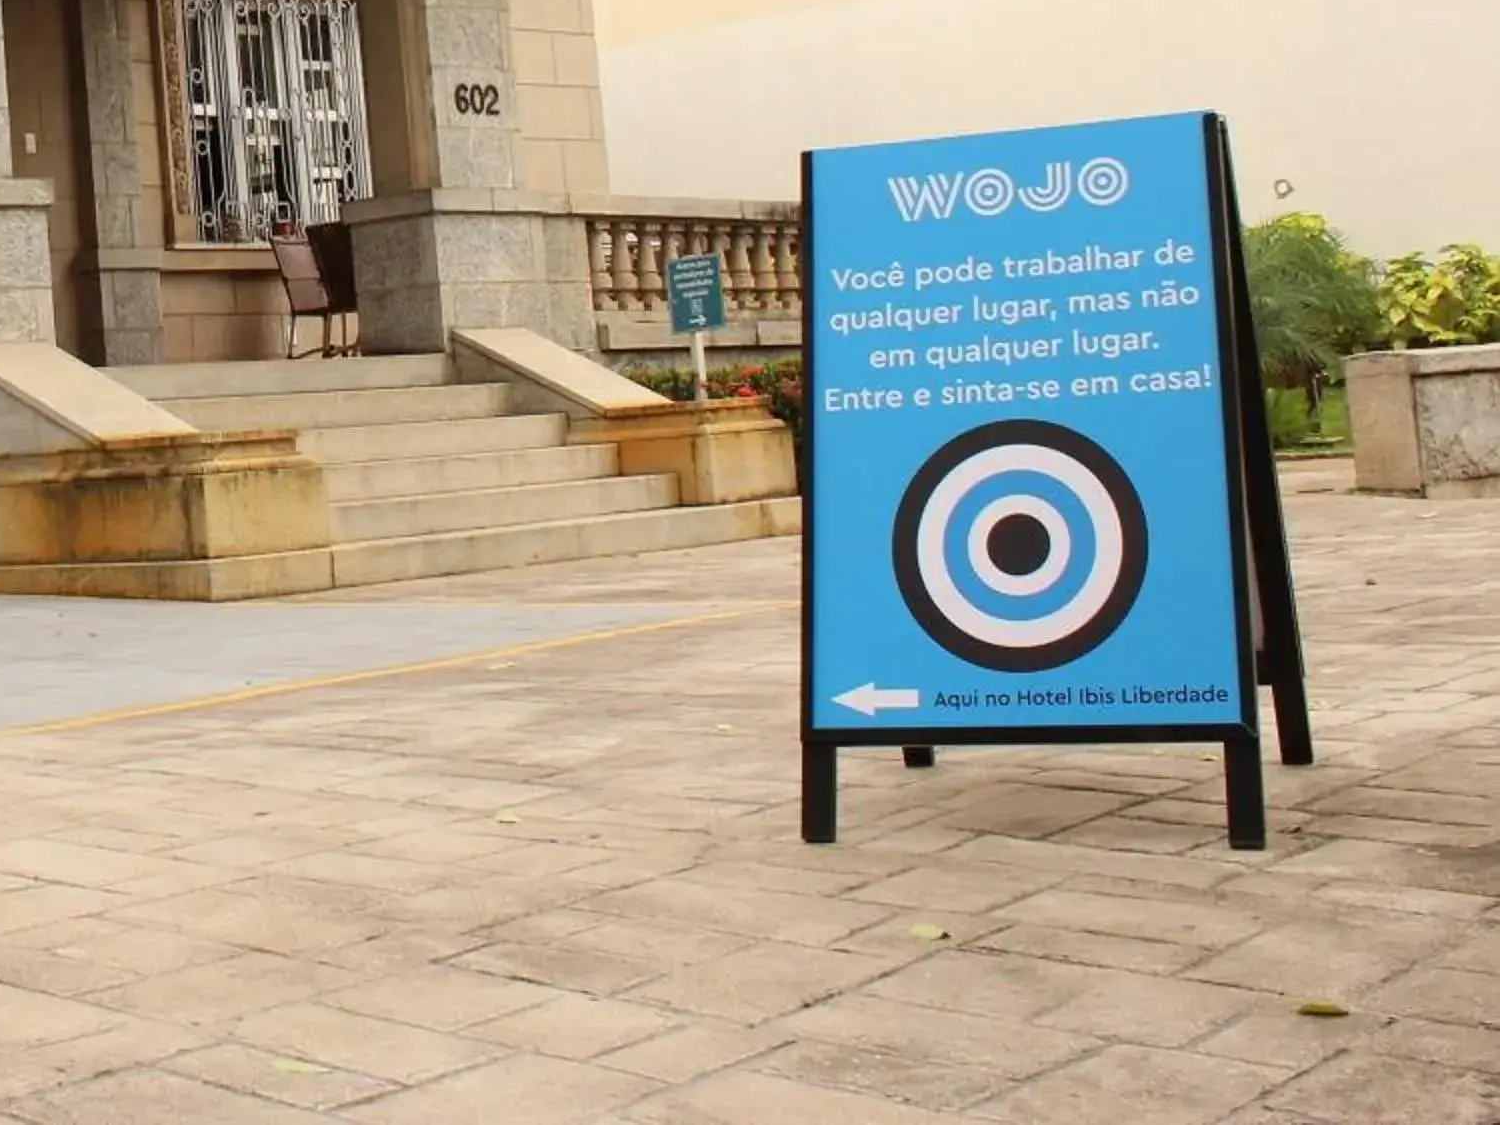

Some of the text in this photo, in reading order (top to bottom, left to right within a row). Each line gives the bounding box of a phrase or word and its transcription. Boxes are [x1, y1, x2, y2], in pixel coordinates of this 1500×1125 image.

[454, 83, 500, 115] 602
[887, 156, 1130, 222] WOJO
[832, 238, 1194, 290] Você pode trabalhar de
[829, 280, 1200, 335] qualquer lugar, mas não
[869, 329, 1159, 370] em qualquer lugar.
[825, 364, 1211, 412] Entre e sinta-se em casa!
[934, 684, 1229, 710] Aqui no Hotel Ibis Liberdade
